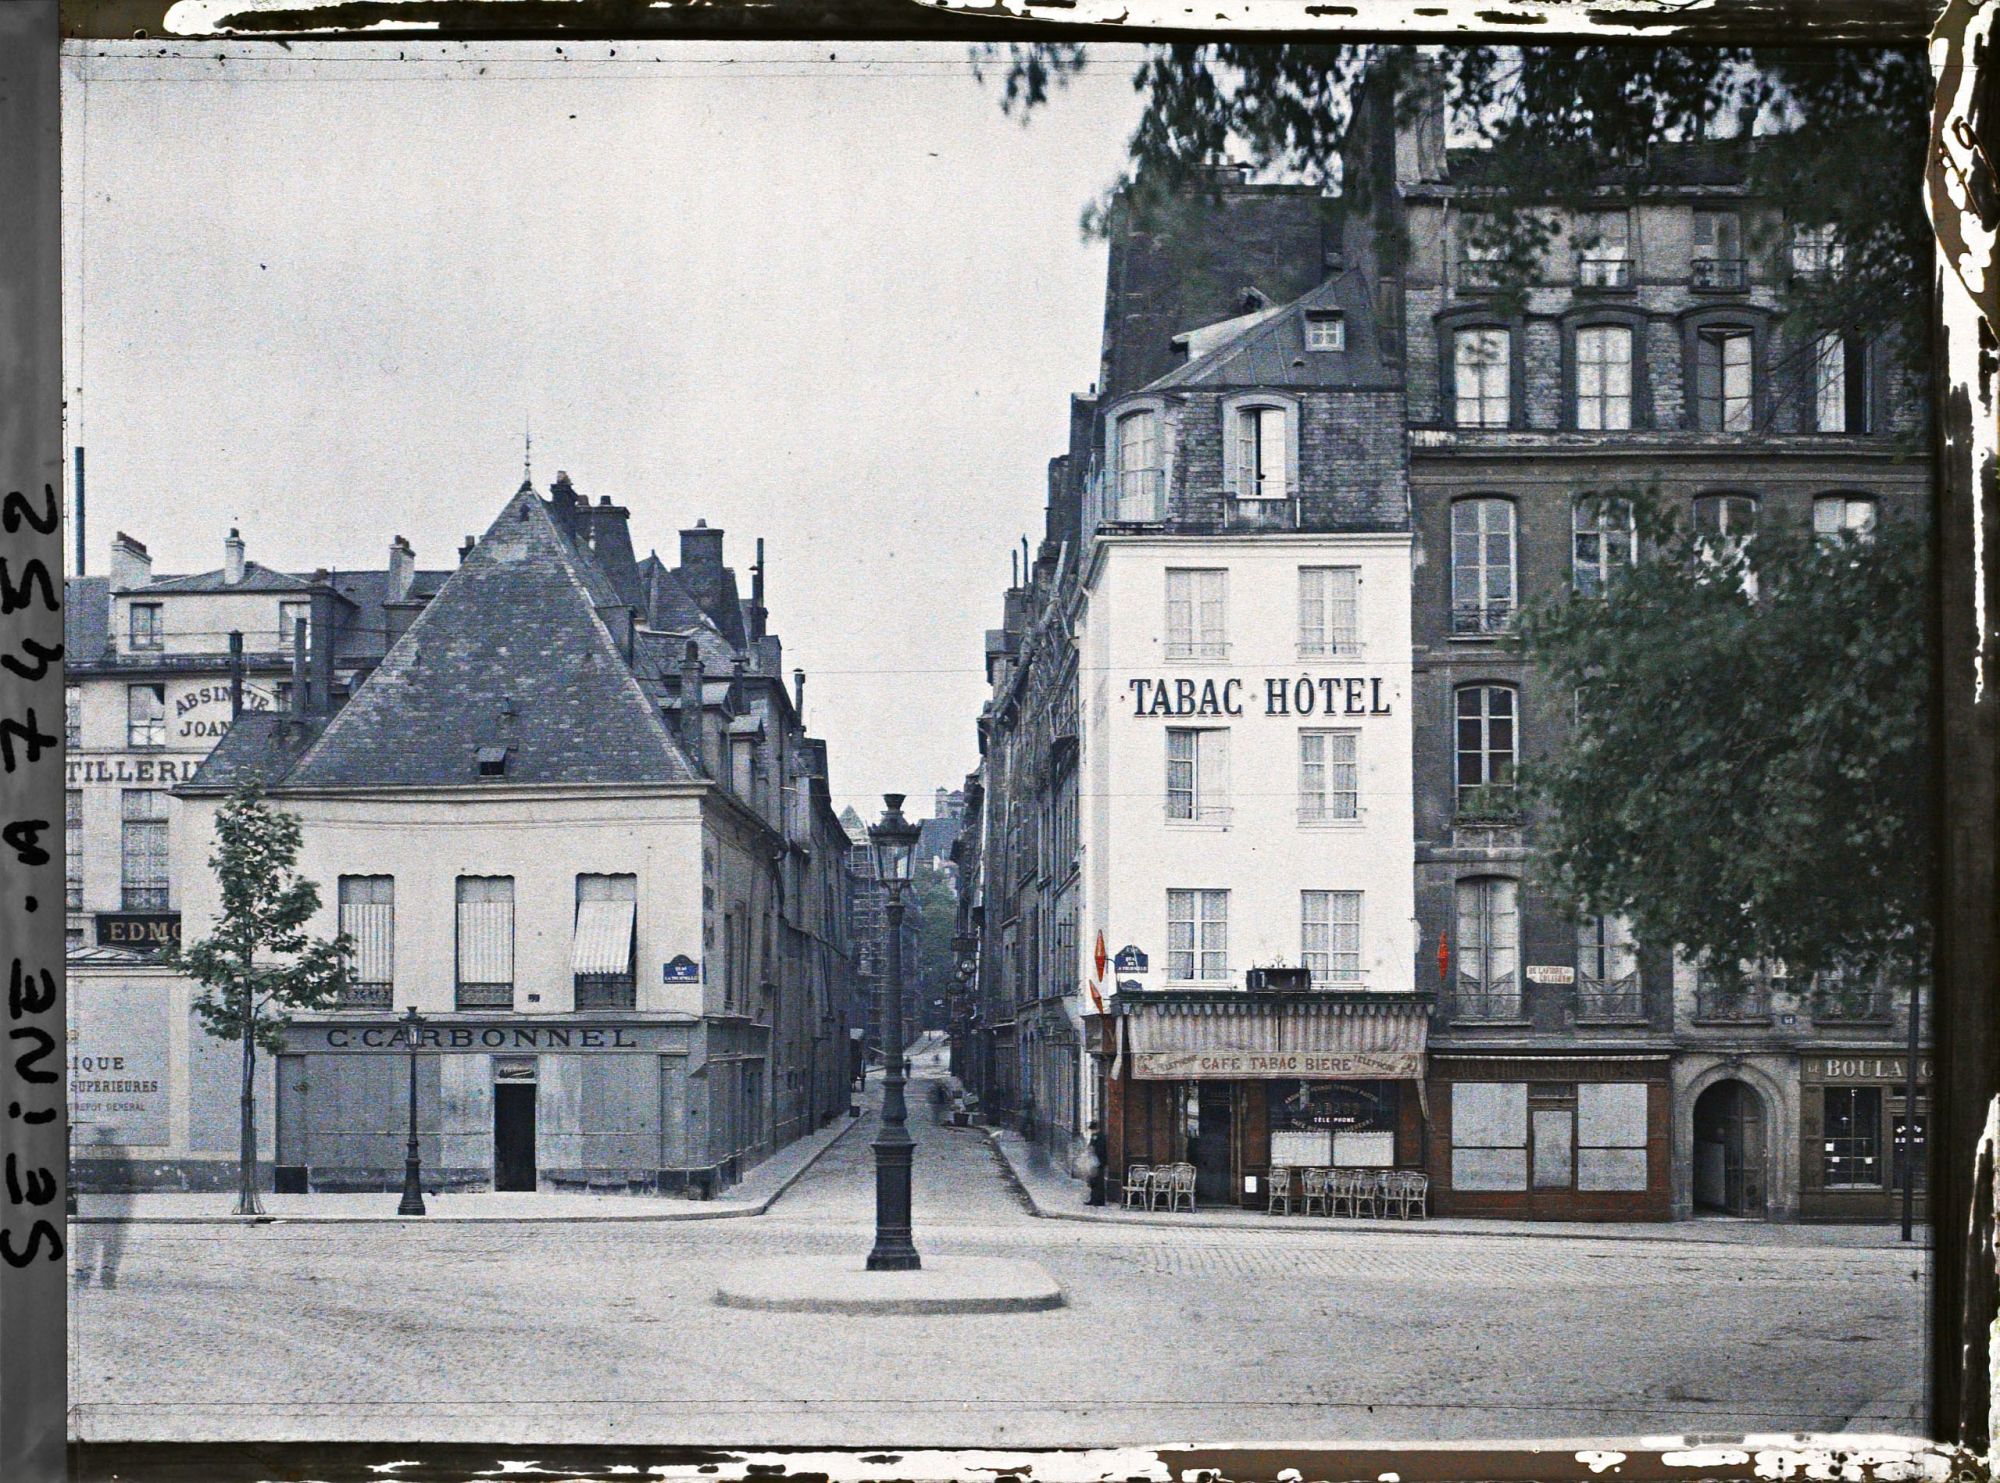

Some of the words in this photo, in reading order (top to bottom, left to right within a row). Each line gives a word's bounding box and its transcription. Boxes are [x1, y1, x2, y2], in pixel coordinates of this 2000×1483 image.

[0, 483, 65, 774] 7452
[1129, 678, 1243, 716] TABAC
[1264, 673, 1391, 716] HÔTEL
[65, 760, 206, 782] TILLERI
[66, 1056, 124, 1072] IQUE
[1250, 1057, 1297, 1071] TABAC
[1826, 1059, 1935, 1078] BOULAG
